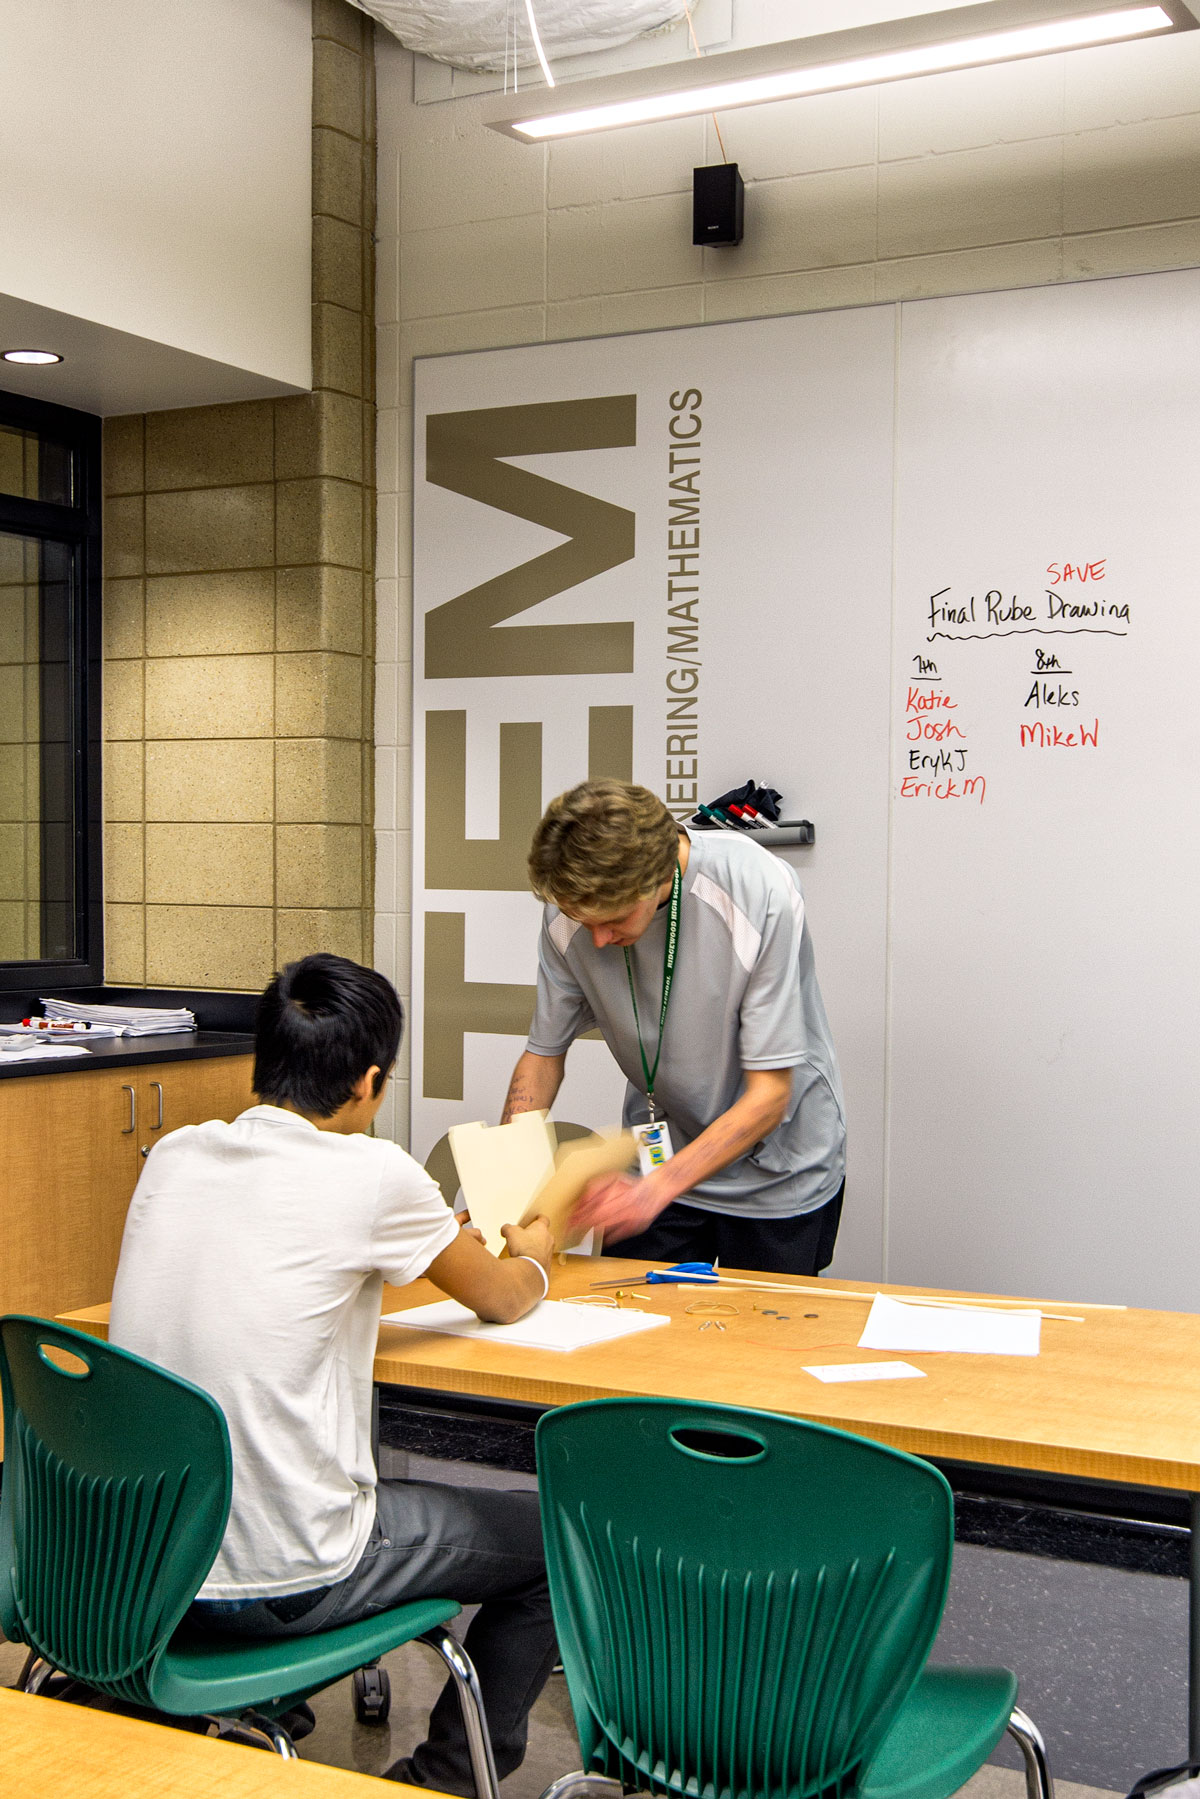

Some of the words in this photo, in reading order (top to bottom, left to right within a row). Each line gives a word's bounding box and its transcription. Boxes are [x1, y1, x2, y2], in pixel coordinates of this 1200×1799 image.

[1046, 559, 1107, 585] SAVE
[927, 586, 976, 628] Final
[984, 589, 1037, 625] Rube
[1034, 648, 1062, 670] 8th
[905, 686, 959, 713] Katie
[1023, 680, 1080, 709] Aleks
[906, 715, 967, 741] Josh
[423, 393, 637, 1256] TEM
[672, 867, 680, 899] SCHOOL
[670, 899, 678, 921] HIGH
[667, 920, 677, 969] RIDGEWOOD
